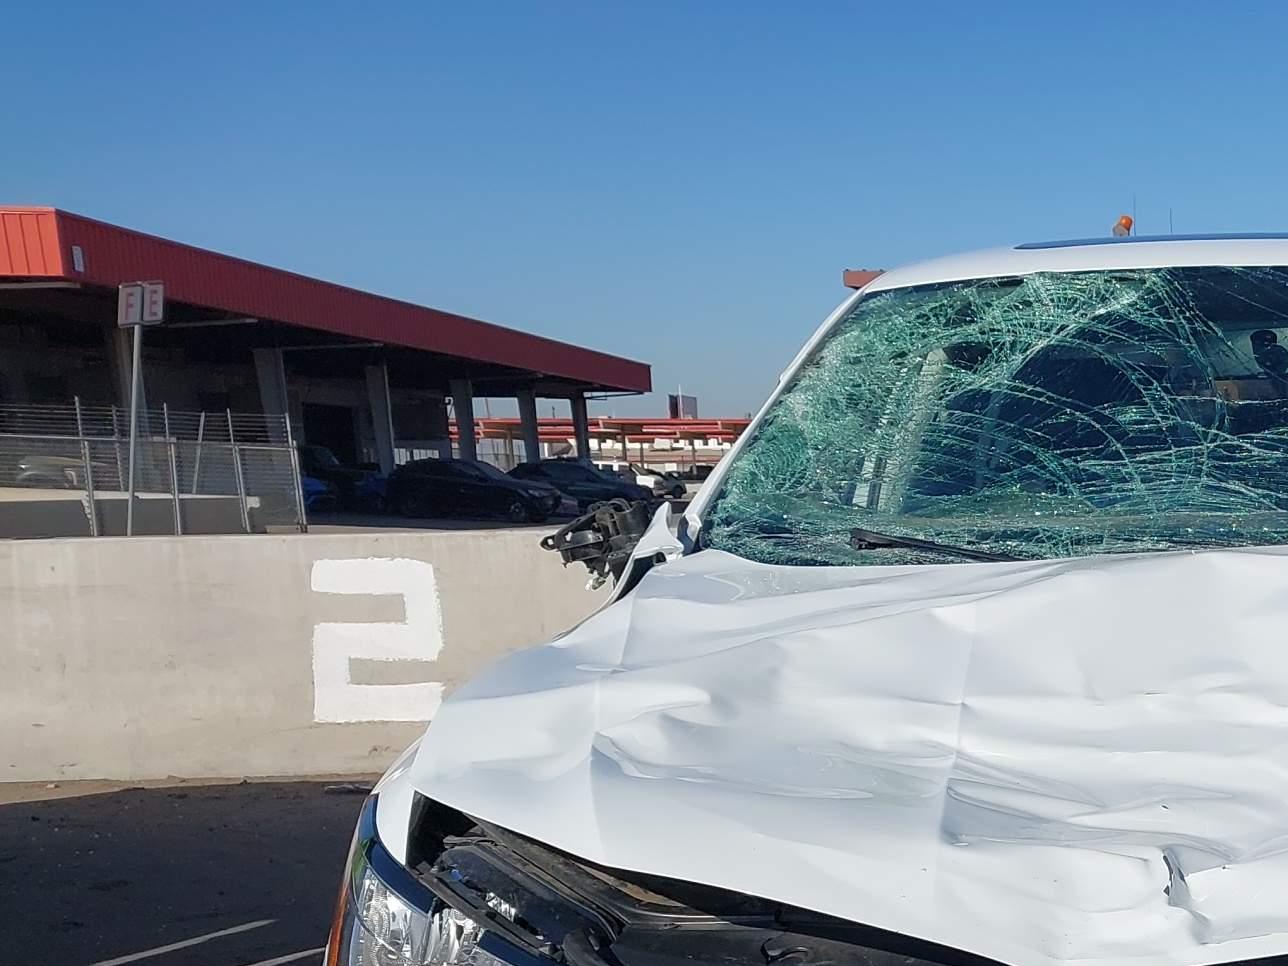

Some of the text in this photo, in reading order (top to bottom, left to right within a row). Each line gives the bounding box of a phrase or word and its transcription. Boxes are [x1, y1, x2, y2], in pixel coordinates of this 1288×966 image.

[124, 291, 135, 321] F
[149, 289, 158, 317] E
[310, 556, 445, 723] 2
